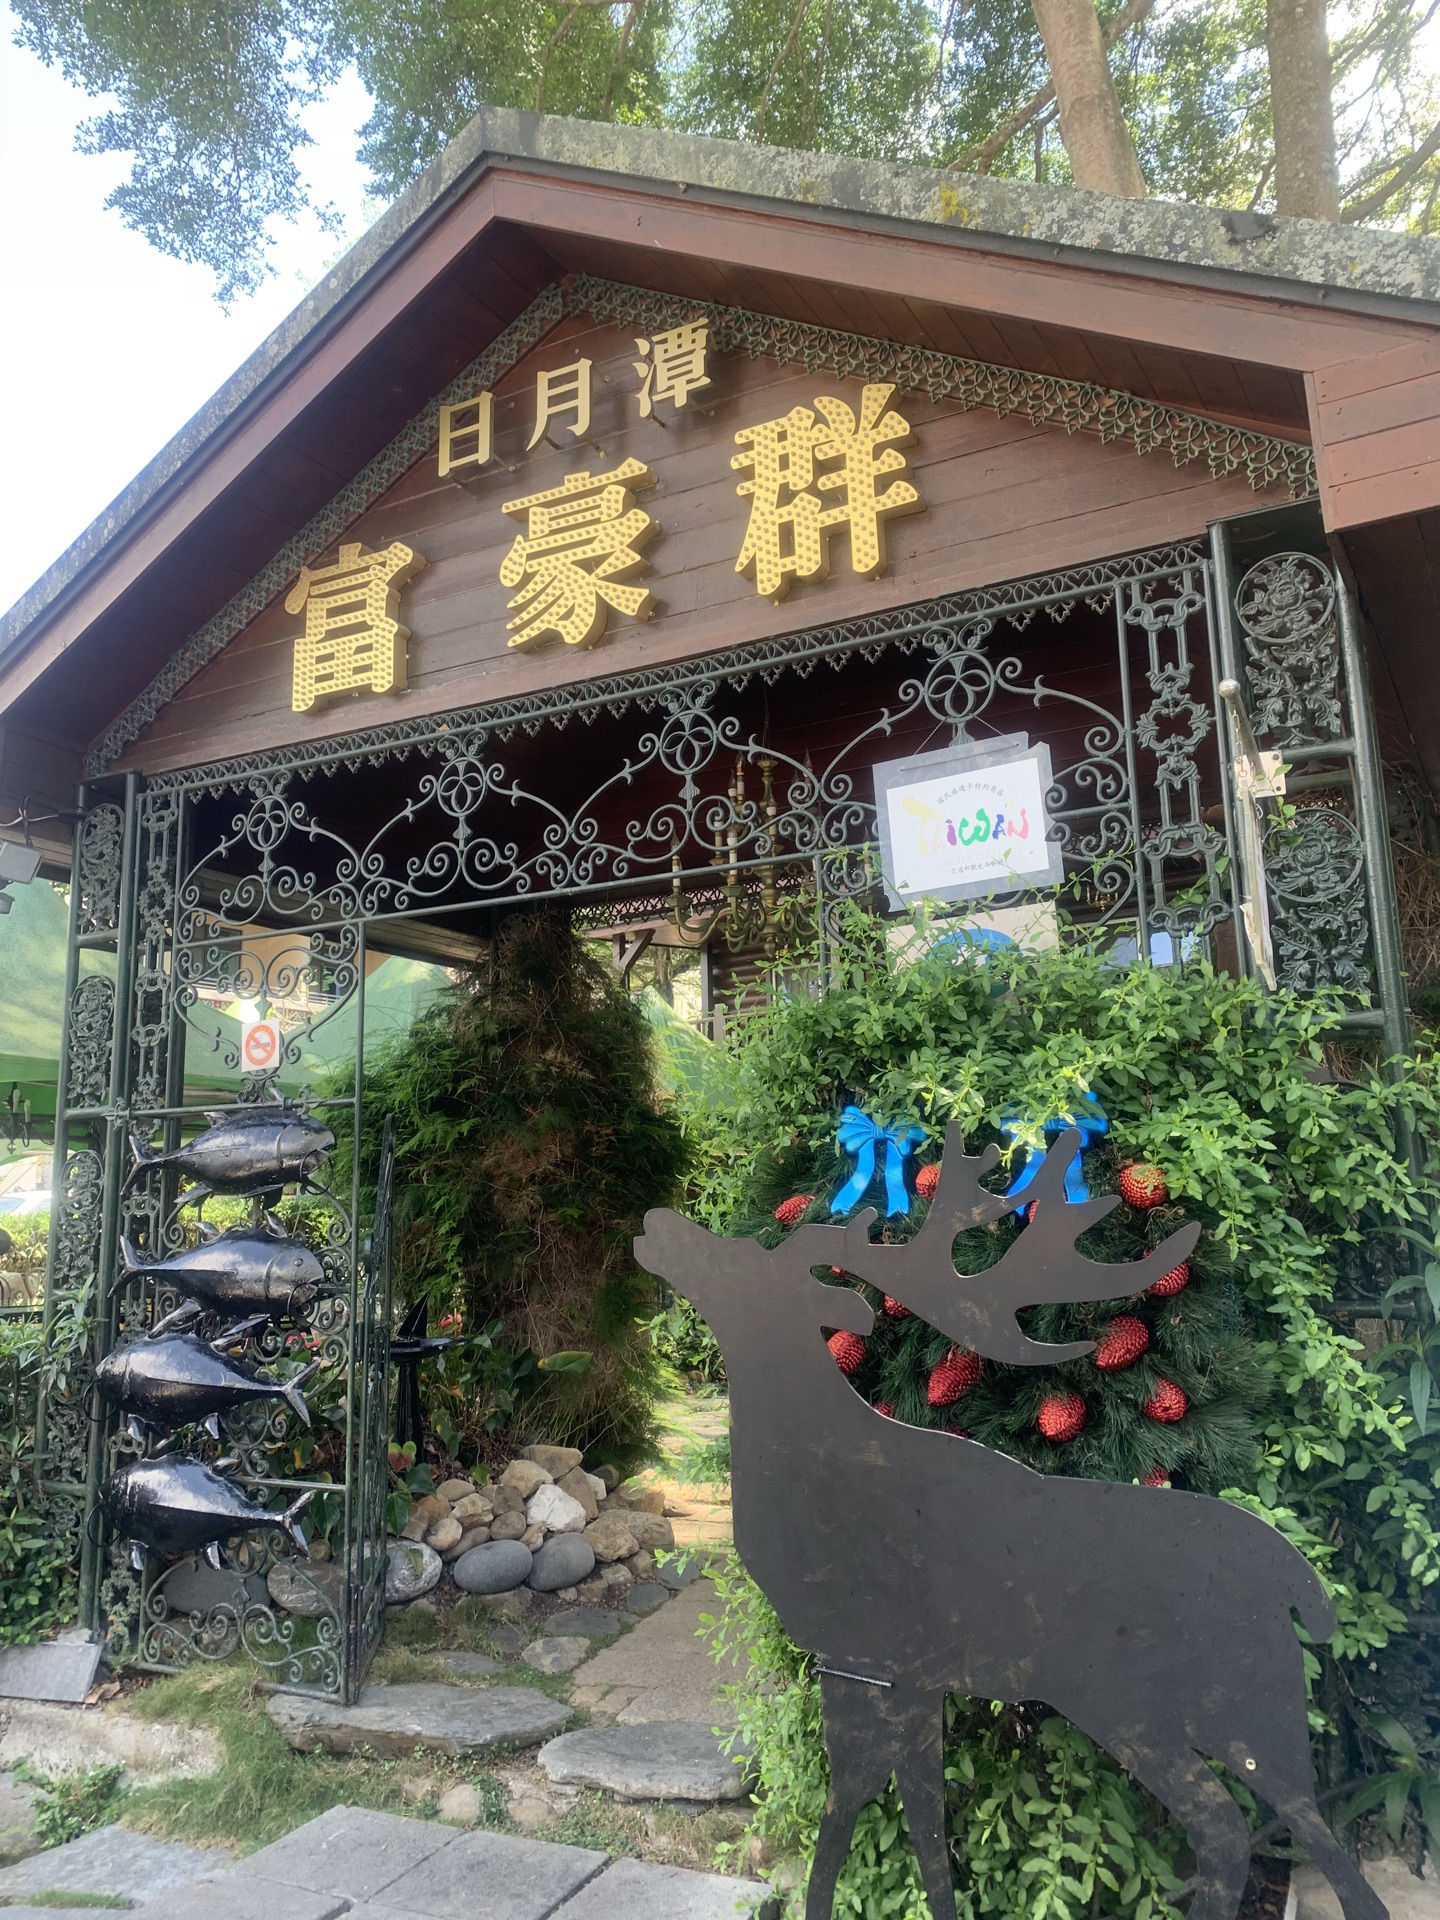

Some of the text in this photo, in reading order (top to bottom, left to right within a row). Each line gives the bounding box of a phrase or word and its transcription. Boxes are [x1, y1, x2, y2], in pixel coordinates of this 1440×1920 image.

[437, 317, 712, 478] 日月潭
[284, 383, 922, 713] 富豪群
